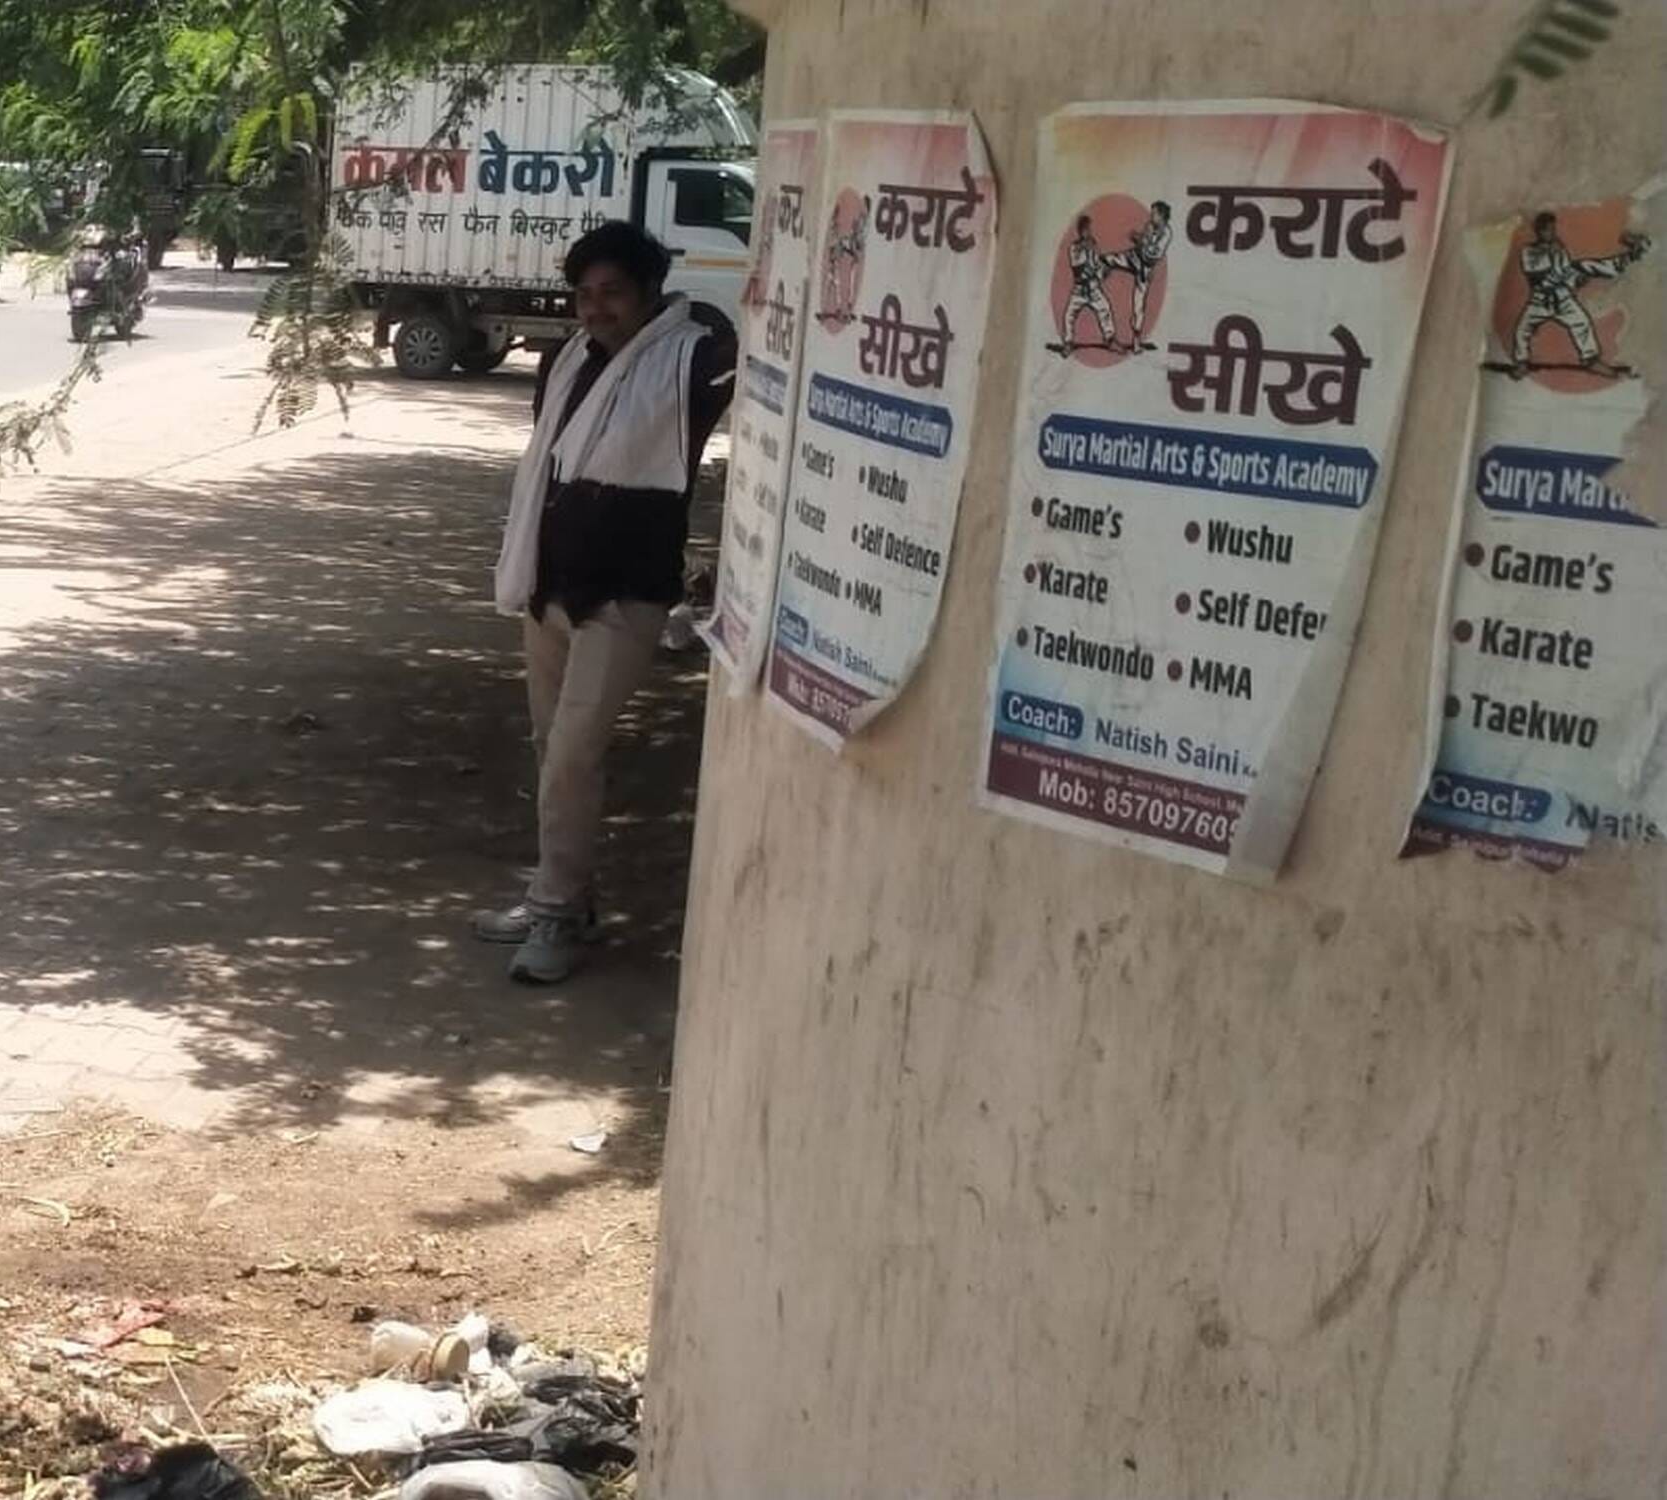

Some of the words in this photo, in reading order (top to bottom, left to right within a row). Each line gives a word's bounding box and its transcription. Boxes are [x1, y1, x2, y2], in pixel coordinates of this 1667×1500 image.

[417, 211, 448, 234] रस
[461, 205, 500, 236] फैन
[510, 208, 573, 244] बिस्कुट
[875, 166, 984, 252] कराटे
[1186, 158, 1417, 263] कराटे
[859, 294, 954, 389] सीखे
[1167, 314, 1371, 426] सीखे
[867, 464, 908, 504] Wushu
[1044, 425, 1086, 463] Surya
[1089, 432, 1149, 470] Martial
[1151, 443, 1186, 476] Arts
[1192, 449, 1203, 477] &
[1209, 446, 1269, 486] Sports
[1273, 457, 1369, 501] Academy
[1483, 460, 1554, 508] Surya
[1047, 497, 1124, 540] Game's
[1207, 518, 1294, 564] Wushu
[860, 522, 882, 553] Self
[885, 528, 940, 577] Defence
[1491, 544, 1614, 594] Game's
[853, 579, 882, 616] MMA
[1039, 560, 1108, 604] Karate
[1197, 589, 1249, 628] Self
[1034, 626, 1155, 682] Taekwondo
[1480, 617, 1593, 670] Karate
[1190, 657, 1252, 700] MMA
[1008, 695, 1078, 736] Coach:
[1096, 718, 1168, 760] Natish
[1176, 736, 1239, 776] Saini
[1471, 693, 1598, 749] Taekwo
[1039, 769, 1097, 810] Mob:
